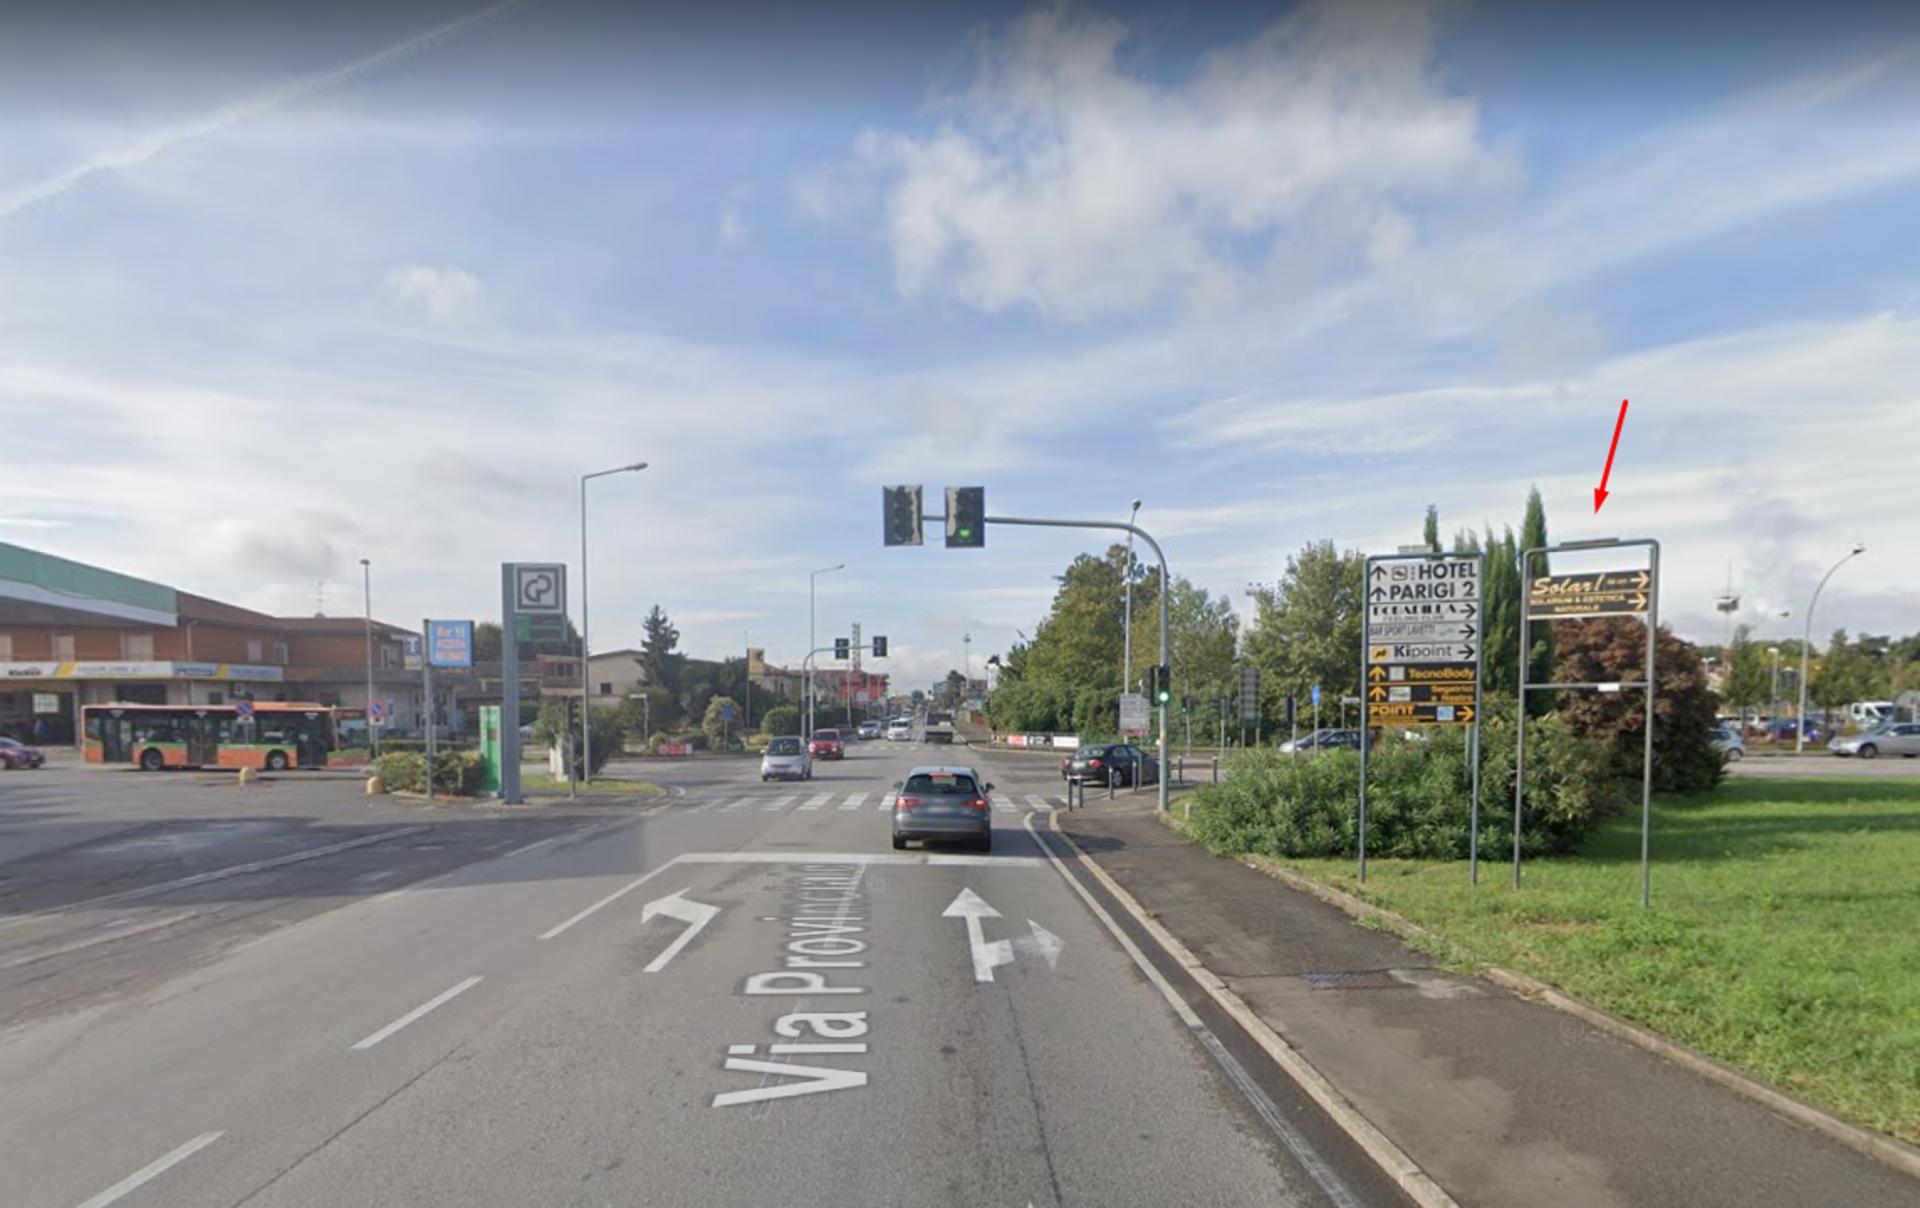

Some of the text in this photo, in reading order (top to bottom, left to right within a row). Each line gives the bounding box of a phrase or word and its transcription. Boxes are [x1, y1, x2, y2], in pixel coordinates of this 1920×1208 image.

[1419, 562, 1476, 580] HOTEL
[1390, 581, 1475, 600] PARIGI 2
[1394, 645, 1451, 659] Kipoint
[1408, 668, 1475, 679] TecnoBody
